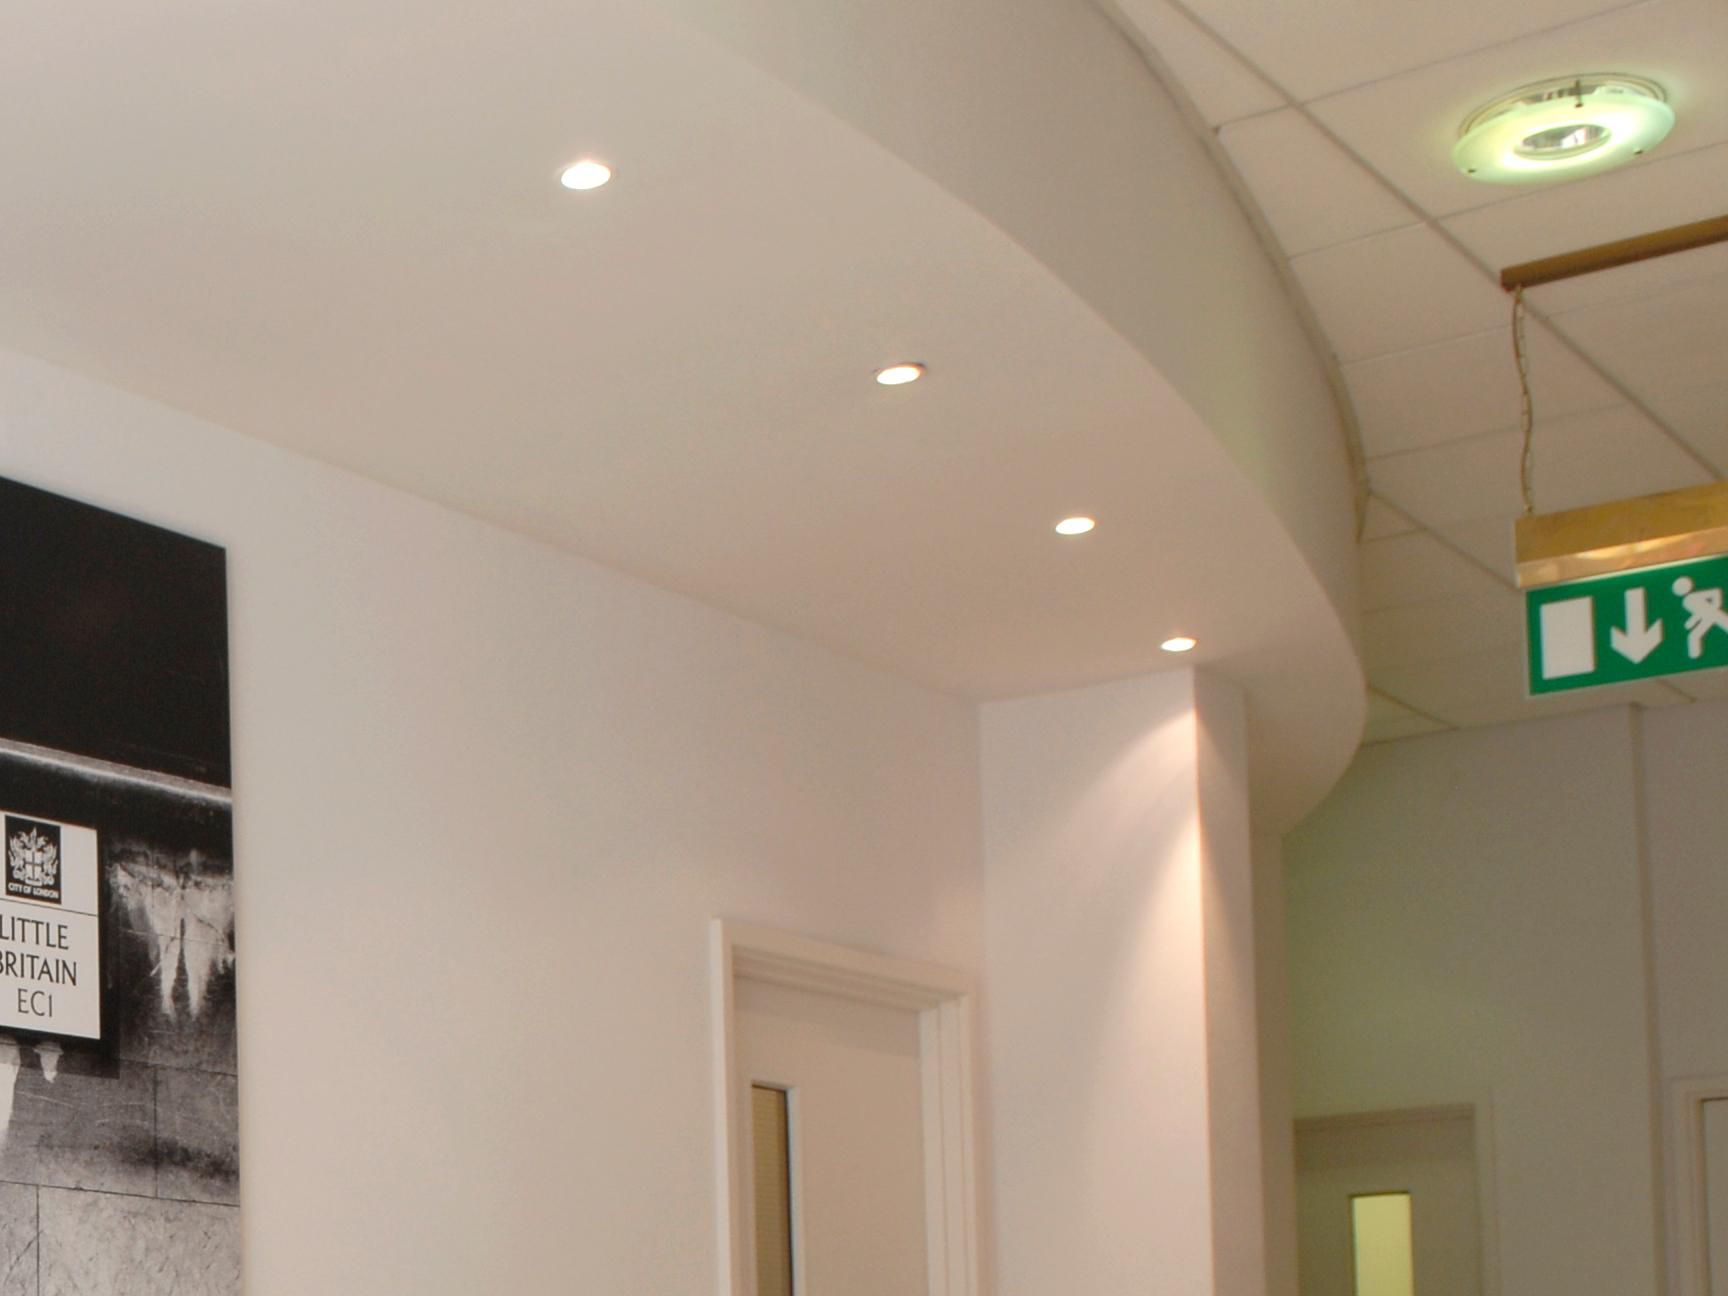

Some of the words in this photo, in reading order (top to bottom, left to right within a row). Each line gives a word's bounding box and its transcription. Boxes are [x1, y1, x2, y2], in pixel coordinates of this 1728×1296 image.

[8, 882, 22, 892] CITY
[33, 887, 59, 899] LONDON
[0, 914, 69, 950] LITTLE
